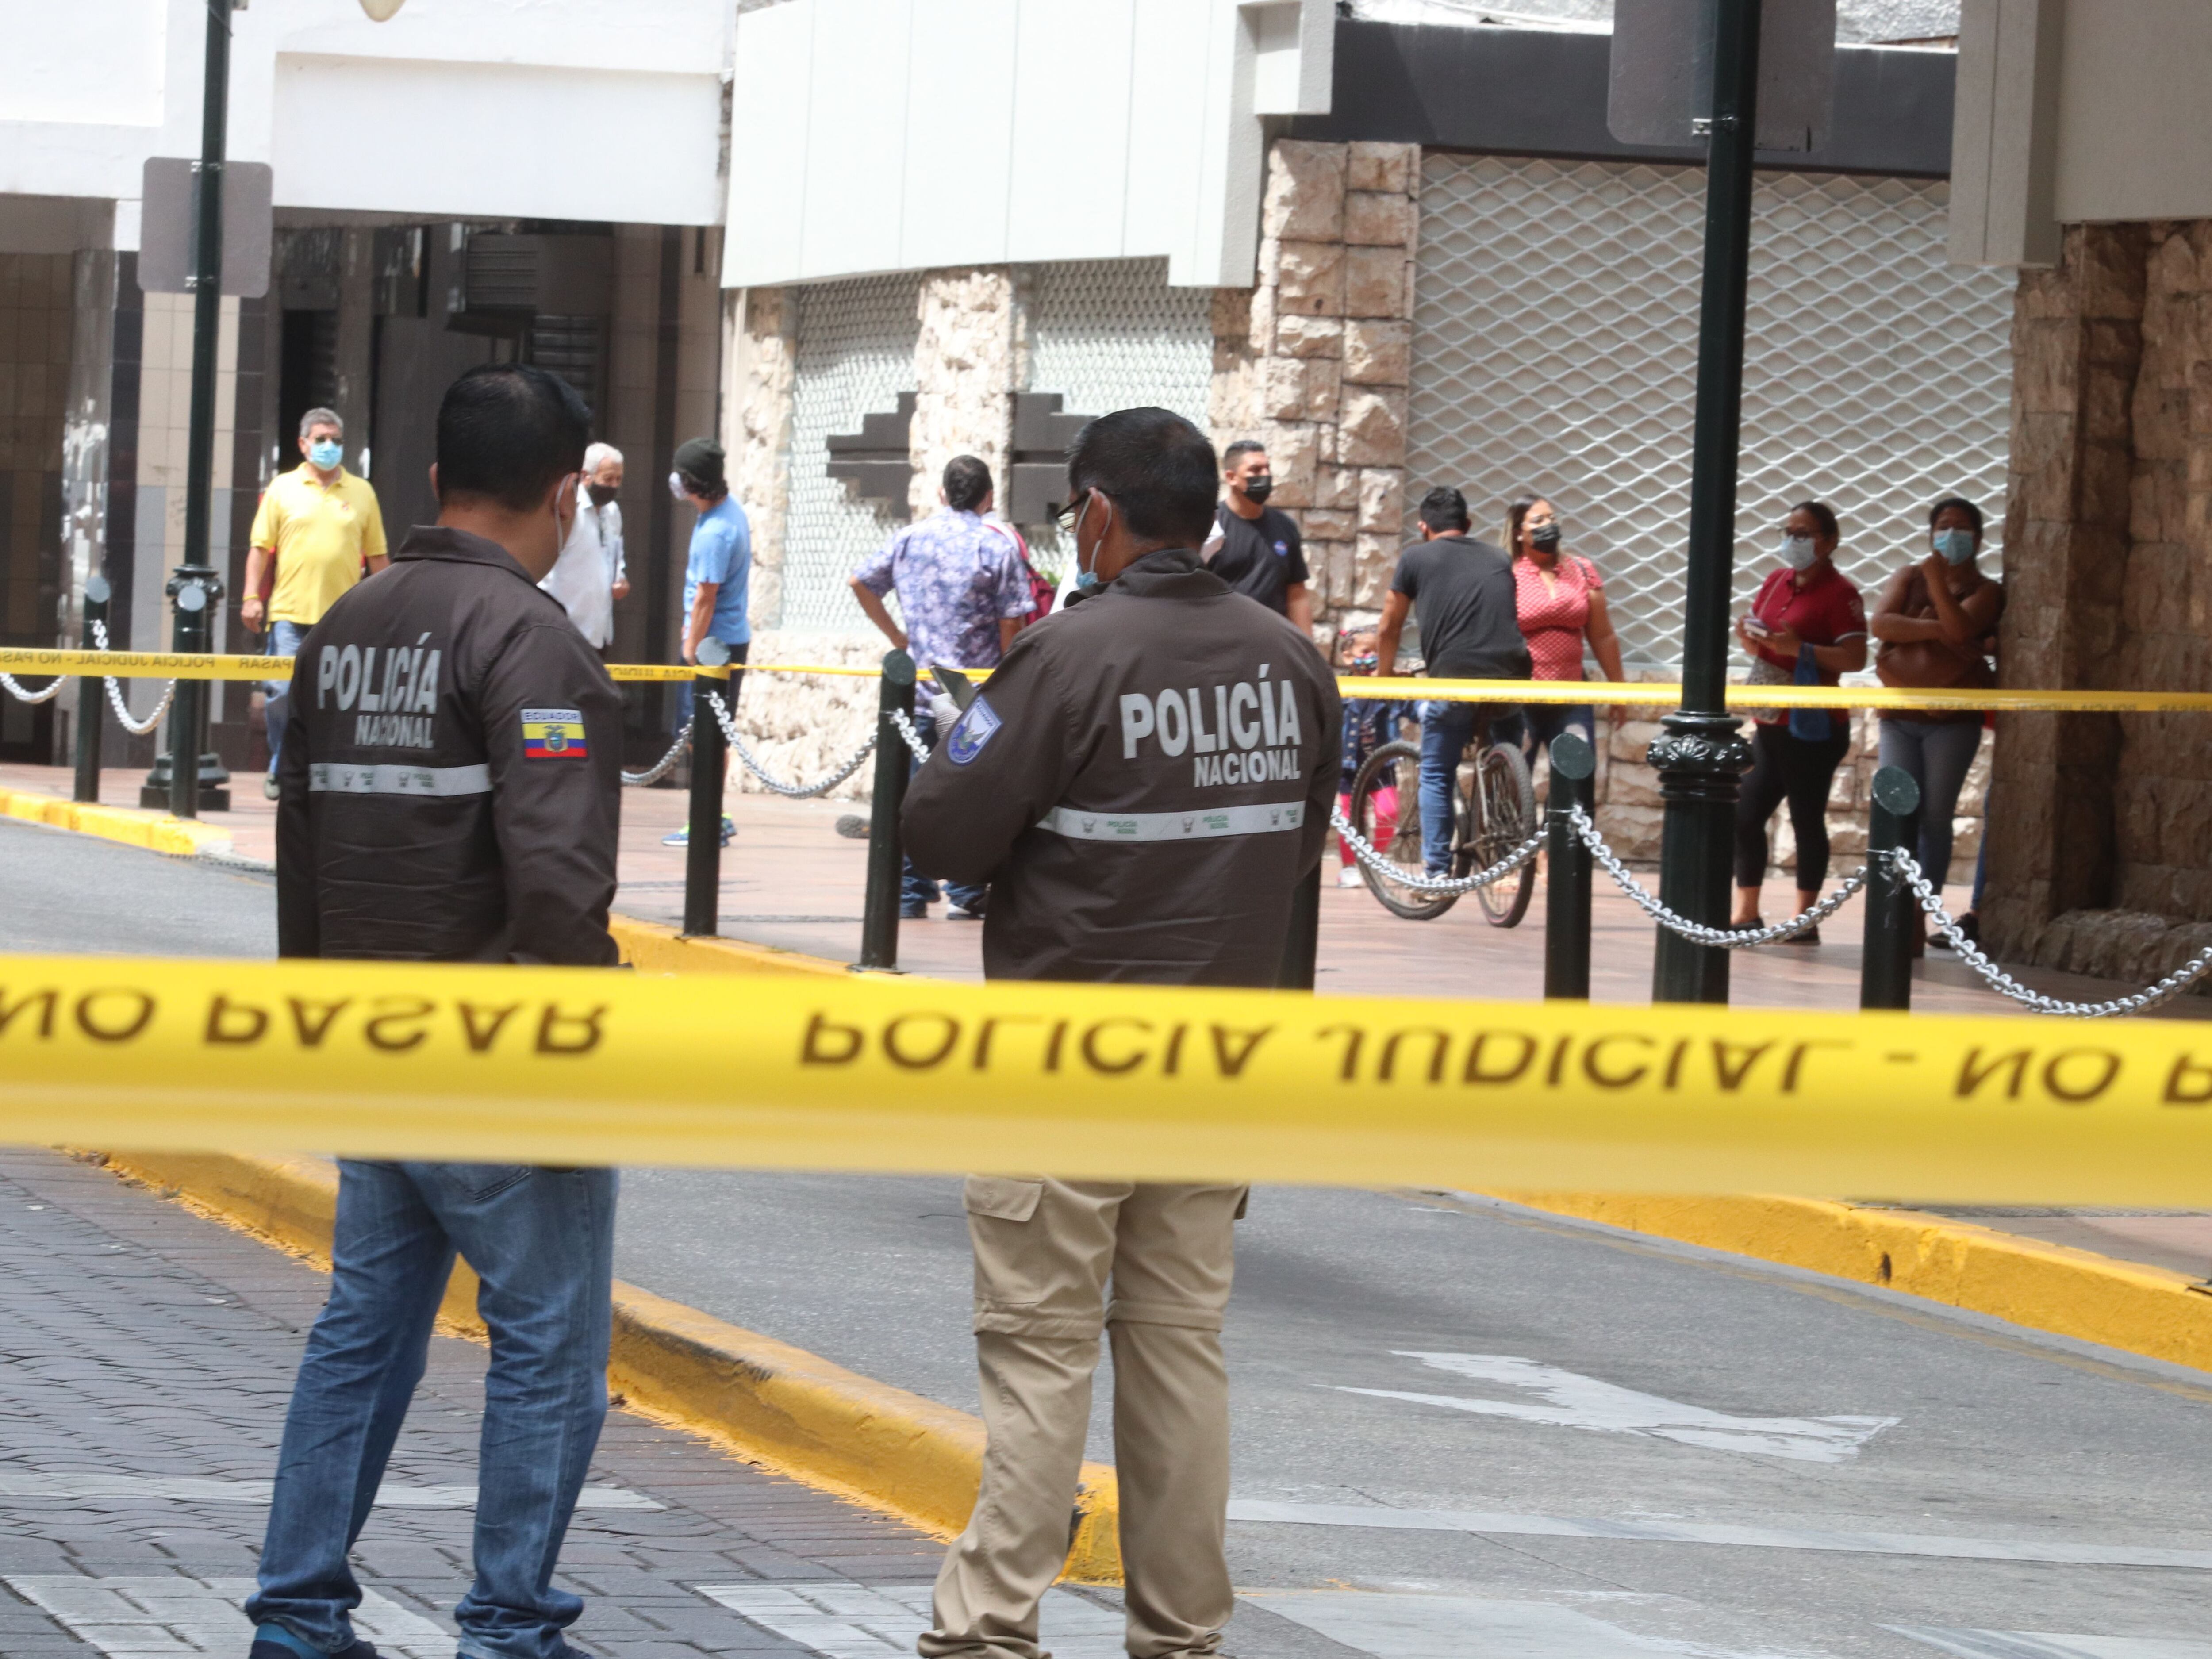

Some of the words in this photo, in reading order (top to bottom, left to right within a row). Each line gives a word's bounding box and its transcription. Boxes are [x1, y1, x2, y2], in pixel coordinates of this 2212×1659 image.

[317, 632, 442, 714] POLICÍA
[525, 711, 577, 720] ECUADOR
[1120, 664, 1302, 759] POLICÍA
[355, 715, 434, 749] NACONAL
[1194, 749, 1301, 787] NACIONAL
